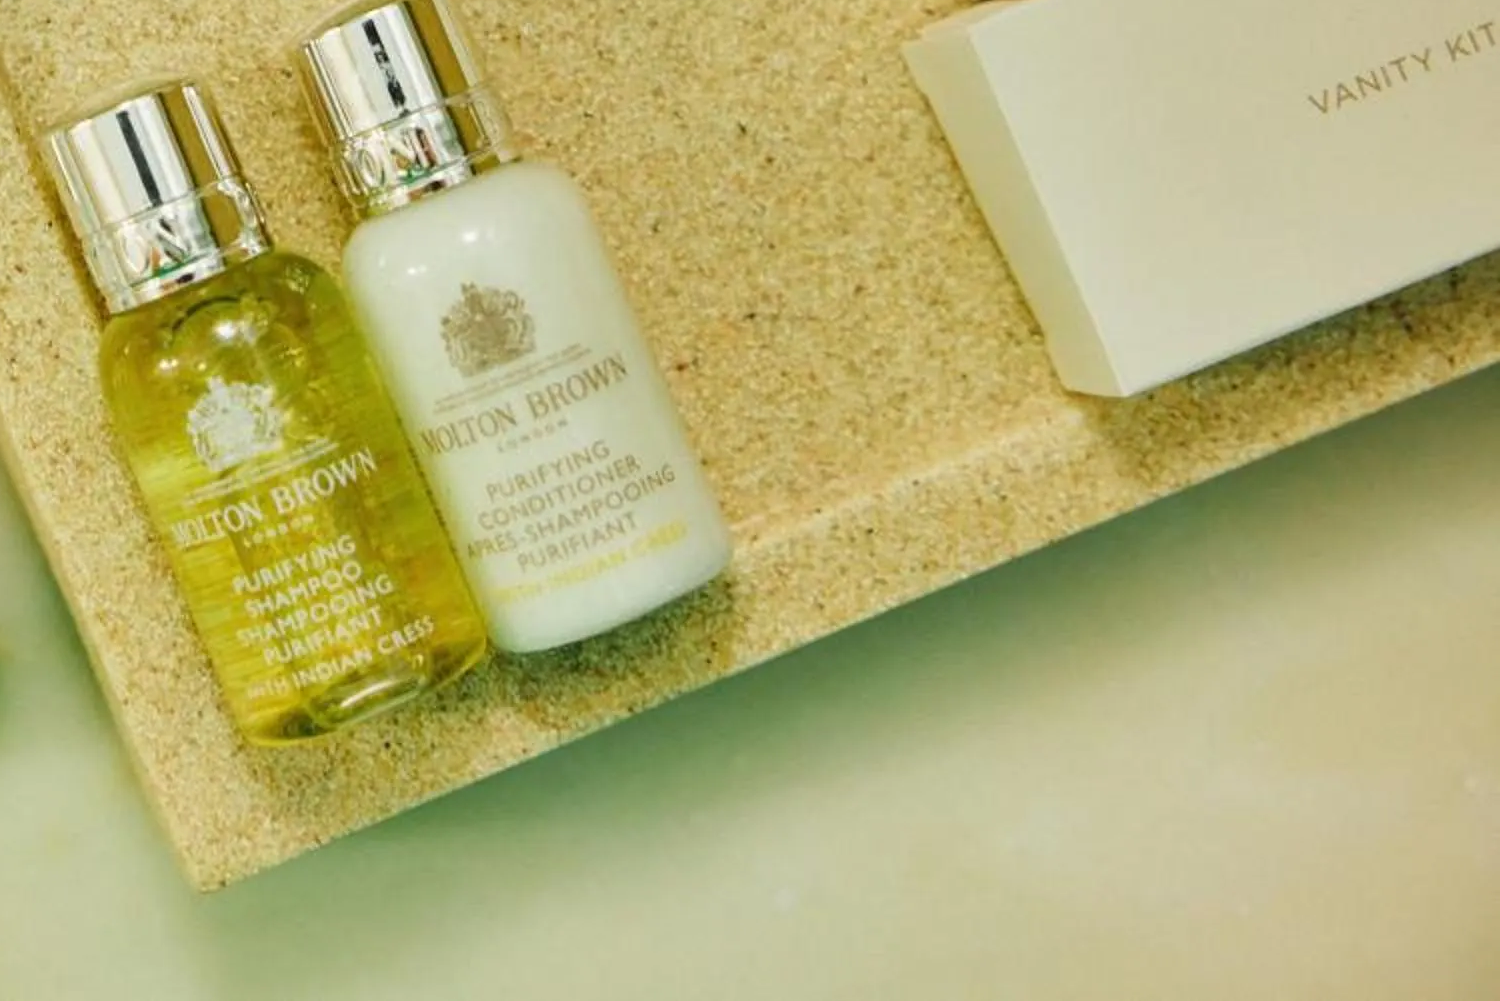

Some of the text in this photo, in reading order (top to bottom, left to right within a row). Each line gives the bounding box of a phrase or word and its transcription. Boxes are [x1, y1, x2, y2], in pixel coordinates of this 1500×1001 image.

[1307, 21, 1498, 115] VANITY KIT
[419, 352, 629, 455] MOLTON BROWN
[270, 448, 378, 516] BROWN
[477, 454, 642, 531] CONDITIONER
[485, 439, 611, 503] PURIFYING
[232, 535, 357, 595] PURIFYING
[517, 511, 639, 573] PURIFIANT
[237, 574, 393, 647] SHAMPOOING
[245, 560, 362, 619] SHAMPOO
[264, 605, 382, 666] PURIFIANT
[292, 647, 373, 689] INDIAN
[378, 615, 434, 654] CRESS
